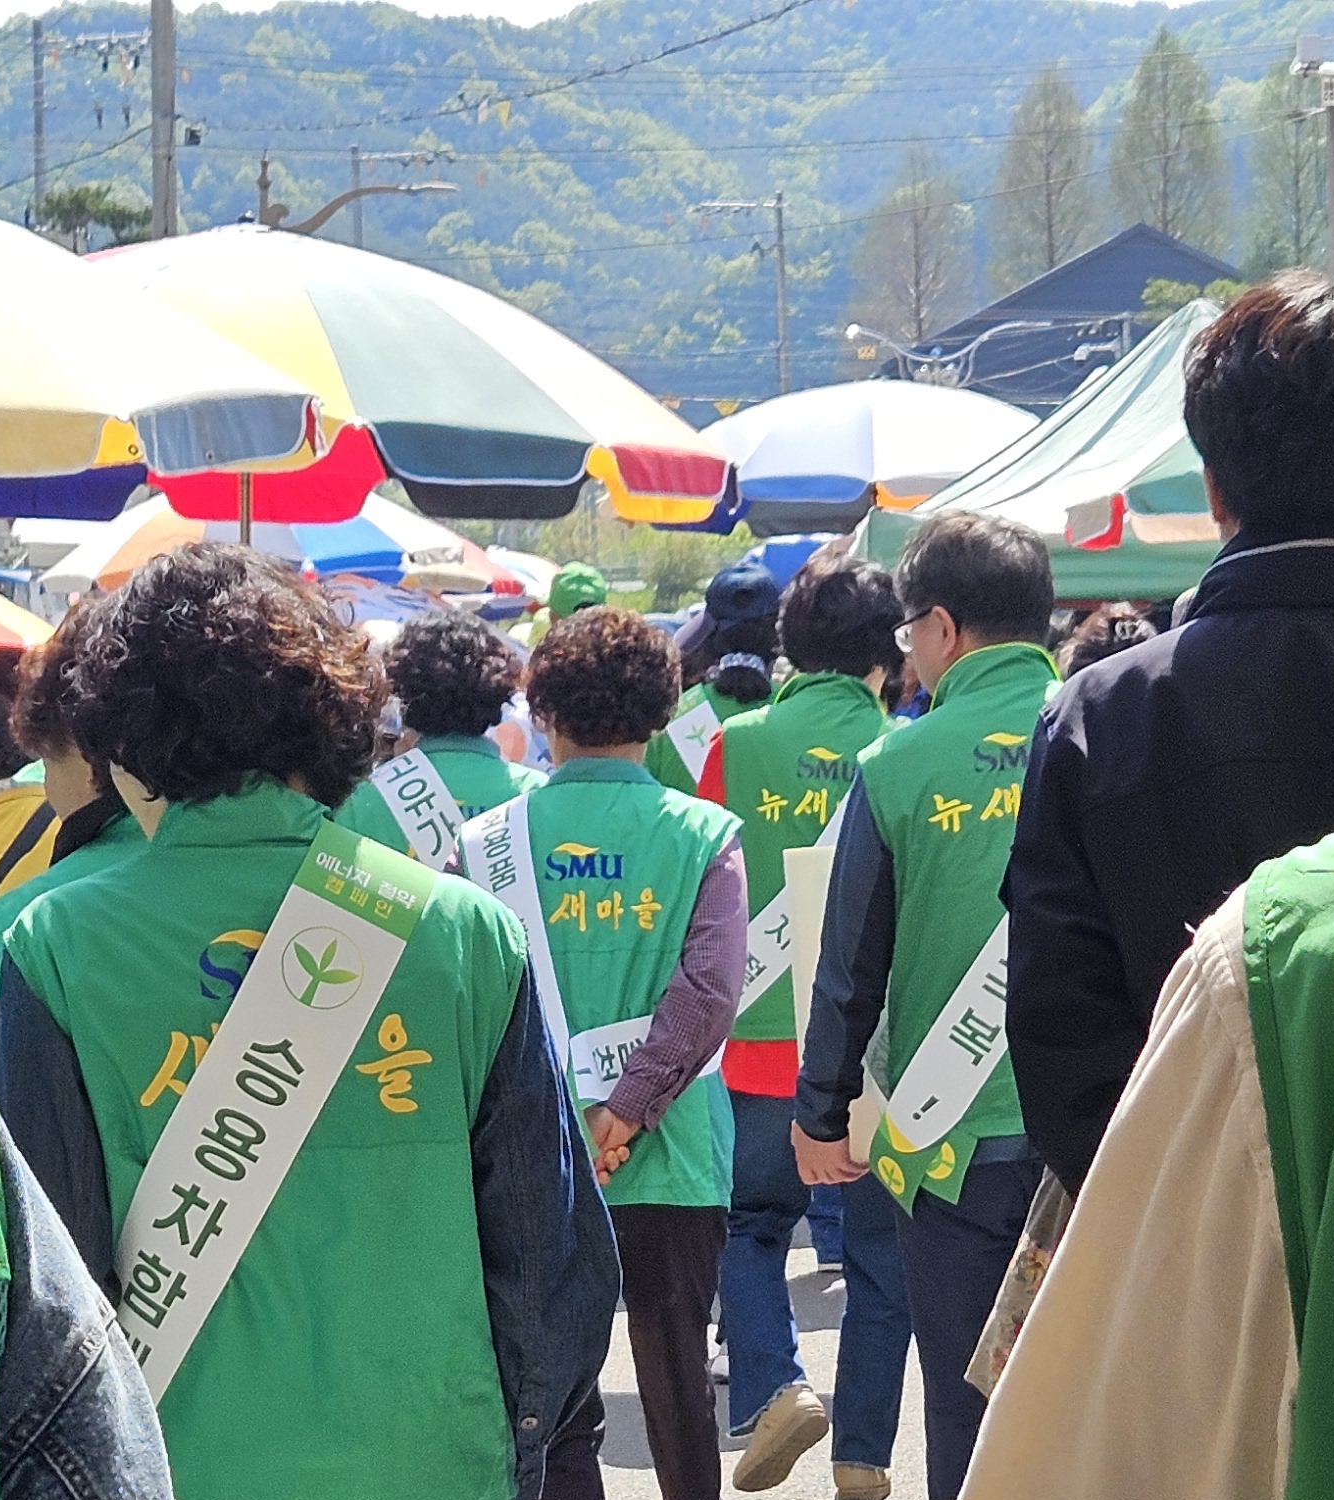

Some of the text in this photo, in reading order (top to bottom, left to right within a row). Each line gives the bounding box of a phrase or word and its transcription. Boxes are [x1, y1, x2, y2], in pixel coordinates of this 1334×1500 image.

[796, 757, 856, 782] SMU
[973, 744, 1027, 773] SM
[316, 852, 416, 910] 에너지 절약
[545, 853, 624, 881] SMU
[549, 887, 662, 931] 새마을
